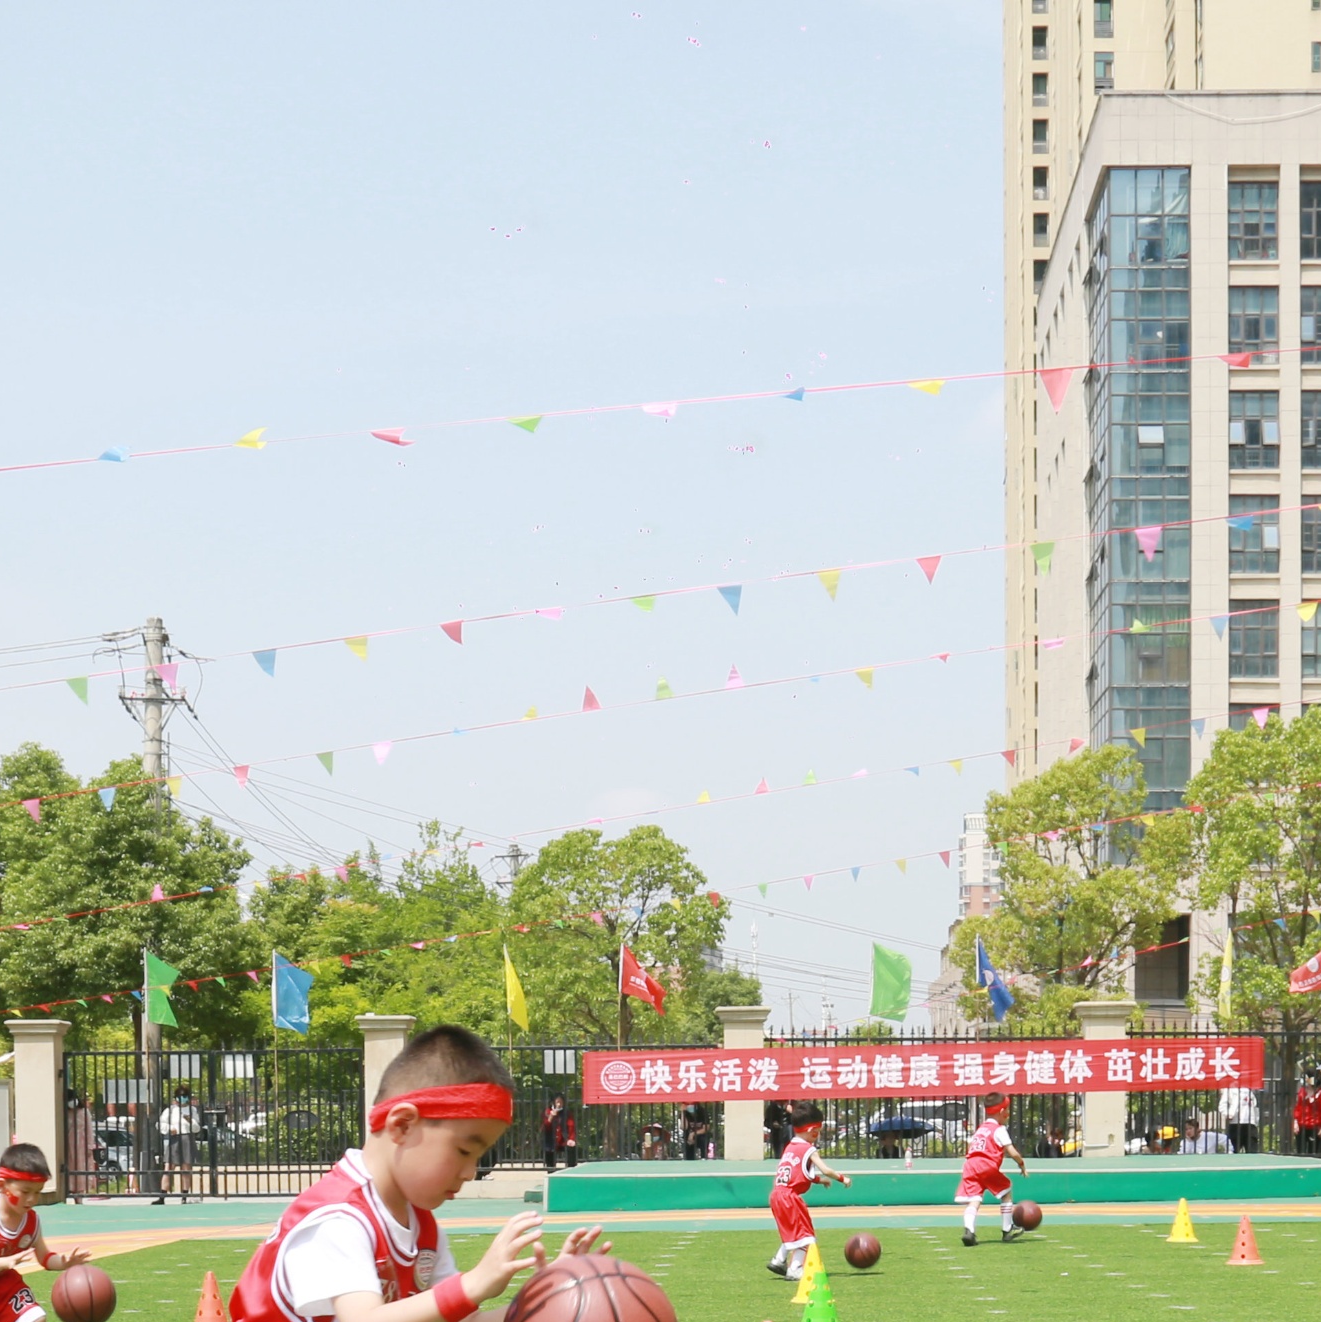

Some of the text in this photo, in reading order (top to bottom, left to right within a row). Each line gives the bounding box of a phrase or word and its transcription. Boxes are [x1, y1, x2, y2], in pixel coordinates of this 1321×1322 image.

[640, 1057, 780, 1094] 快乐活泼
[800, 1053, 941, 1090] 运动健康
[953, 1049, 1093, 1087] 强身健体
[1104, 1046, 1241, 1083] 茁壮成长
[9, 1288, 36, 1314] 23
